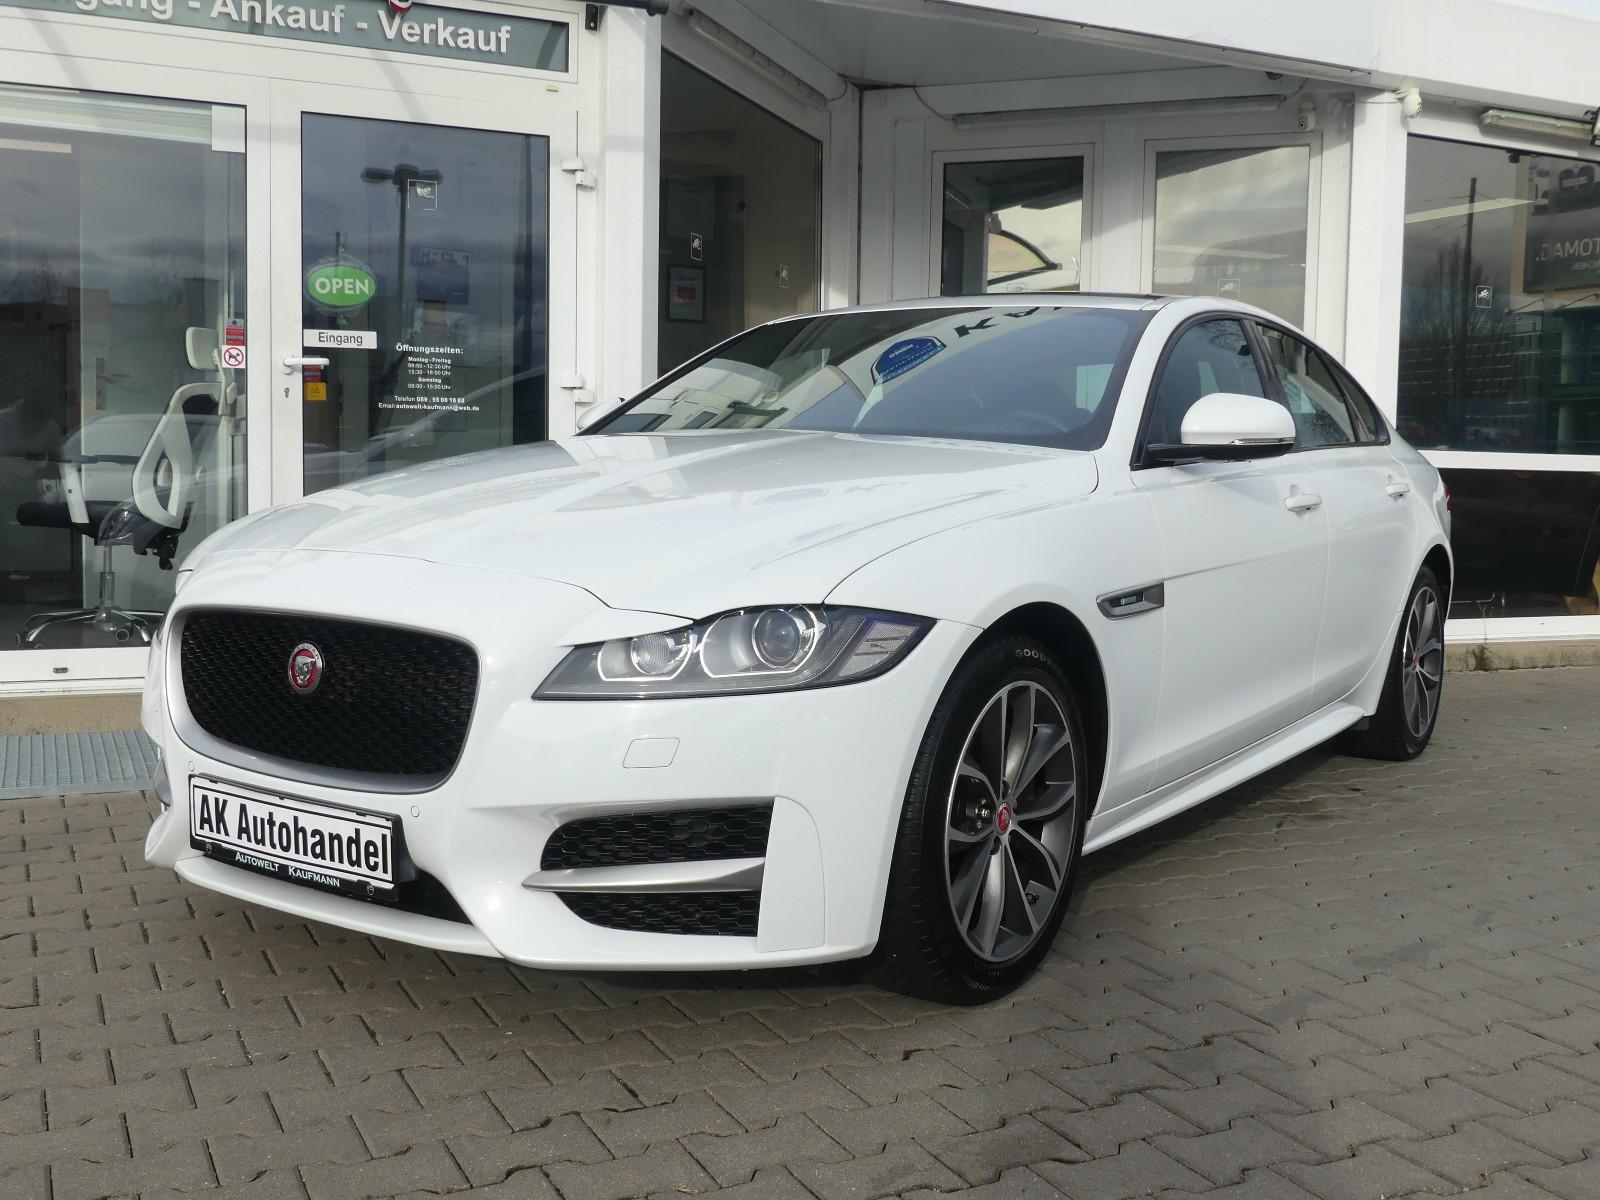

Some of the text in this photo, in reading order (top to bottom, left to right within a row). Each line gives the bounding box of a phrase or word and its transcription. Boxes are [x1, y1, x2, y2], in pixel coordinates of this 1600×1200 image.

[209, 0, 346, 33] Ankauf
[377, 9, 511, 53] Verkauf
[315, 277, 369, 295] OPEN
[319, 331, 363, 345] Eingang
[396, 342, 464, 354] Öffnungszeiten:
[199, 794, 389, 875] AK Autohandel
